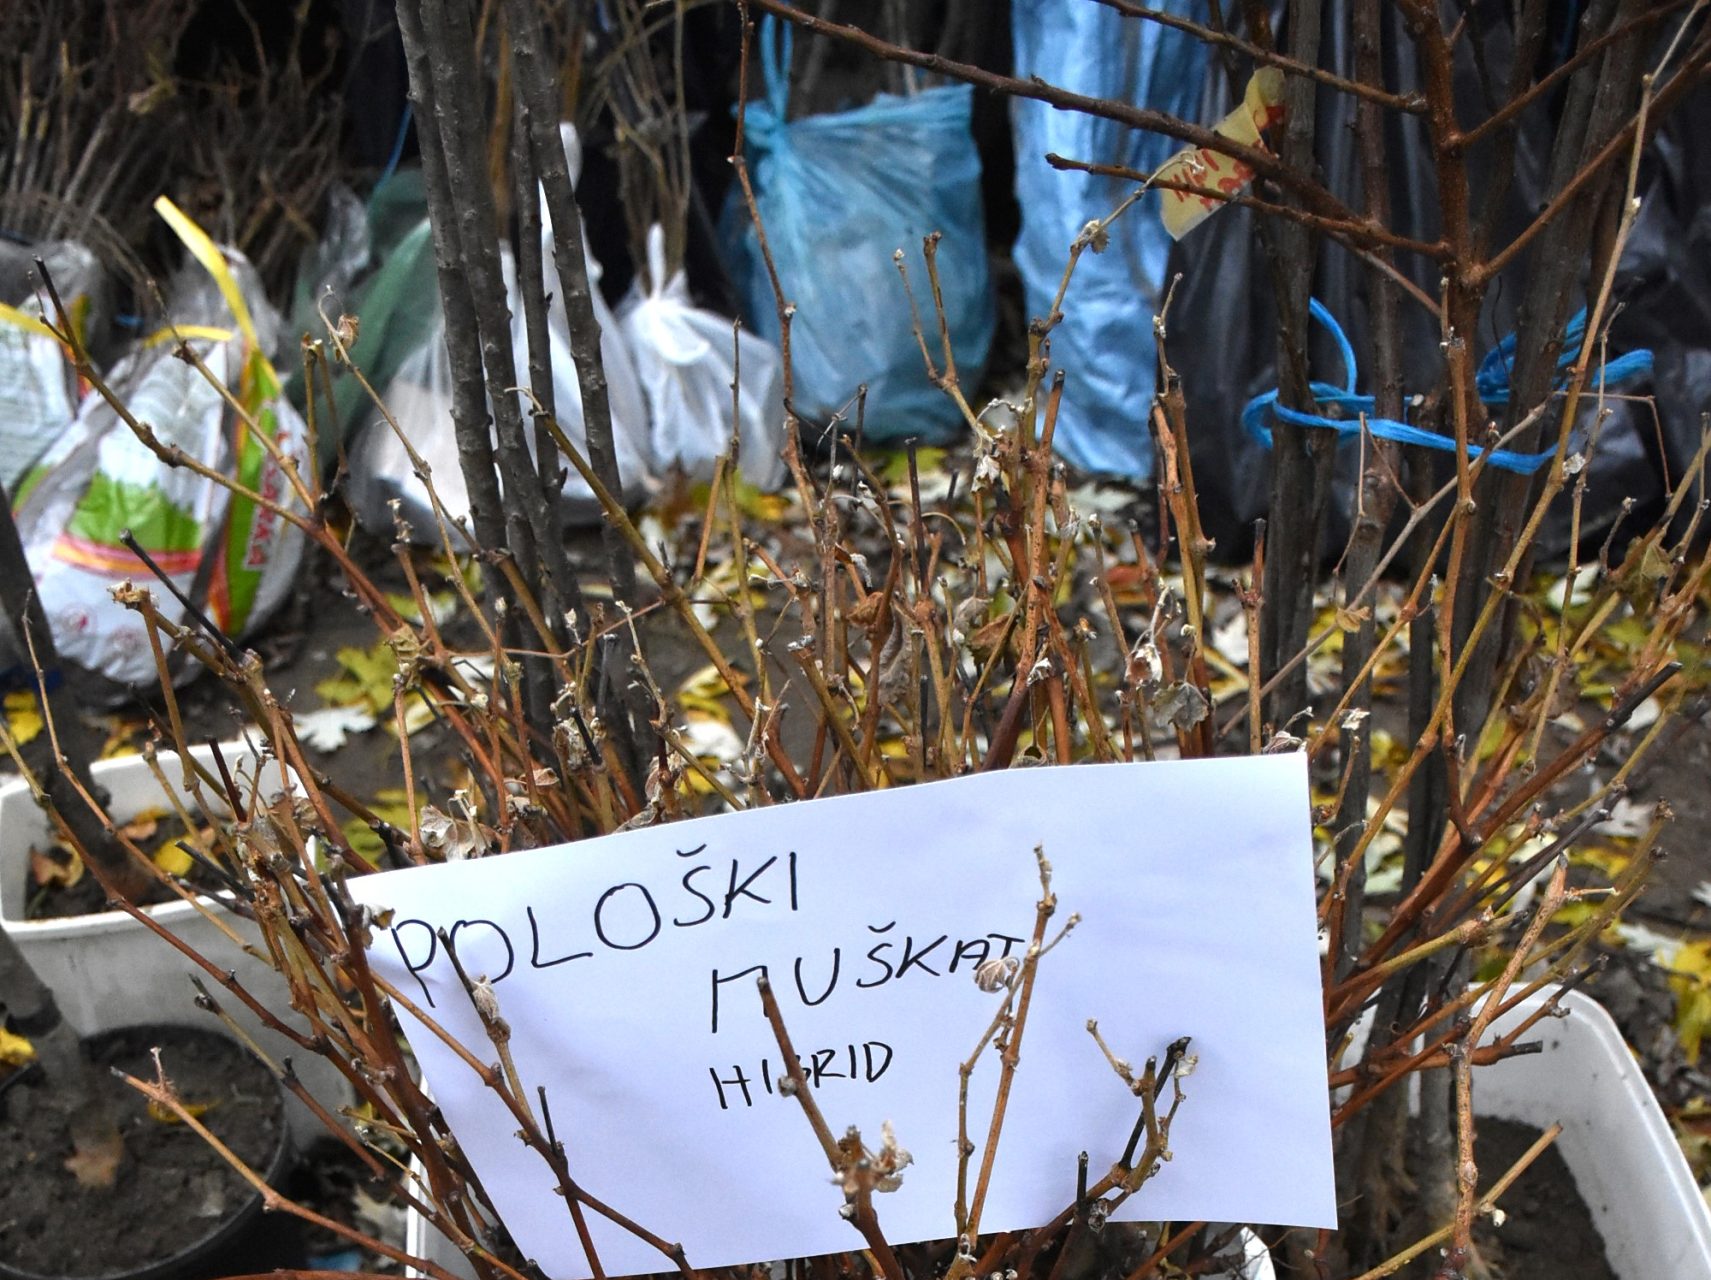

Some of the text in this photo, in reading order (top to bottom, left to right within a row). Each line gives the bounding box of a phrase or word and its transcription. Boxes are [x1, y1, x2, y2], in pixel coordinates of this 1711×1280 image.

[391, 843, 798, 1009] POLOŠKI
[712, 921, 1026, 1034] MUŠKAT
[708, 1041, 894, 1110] HIRID
